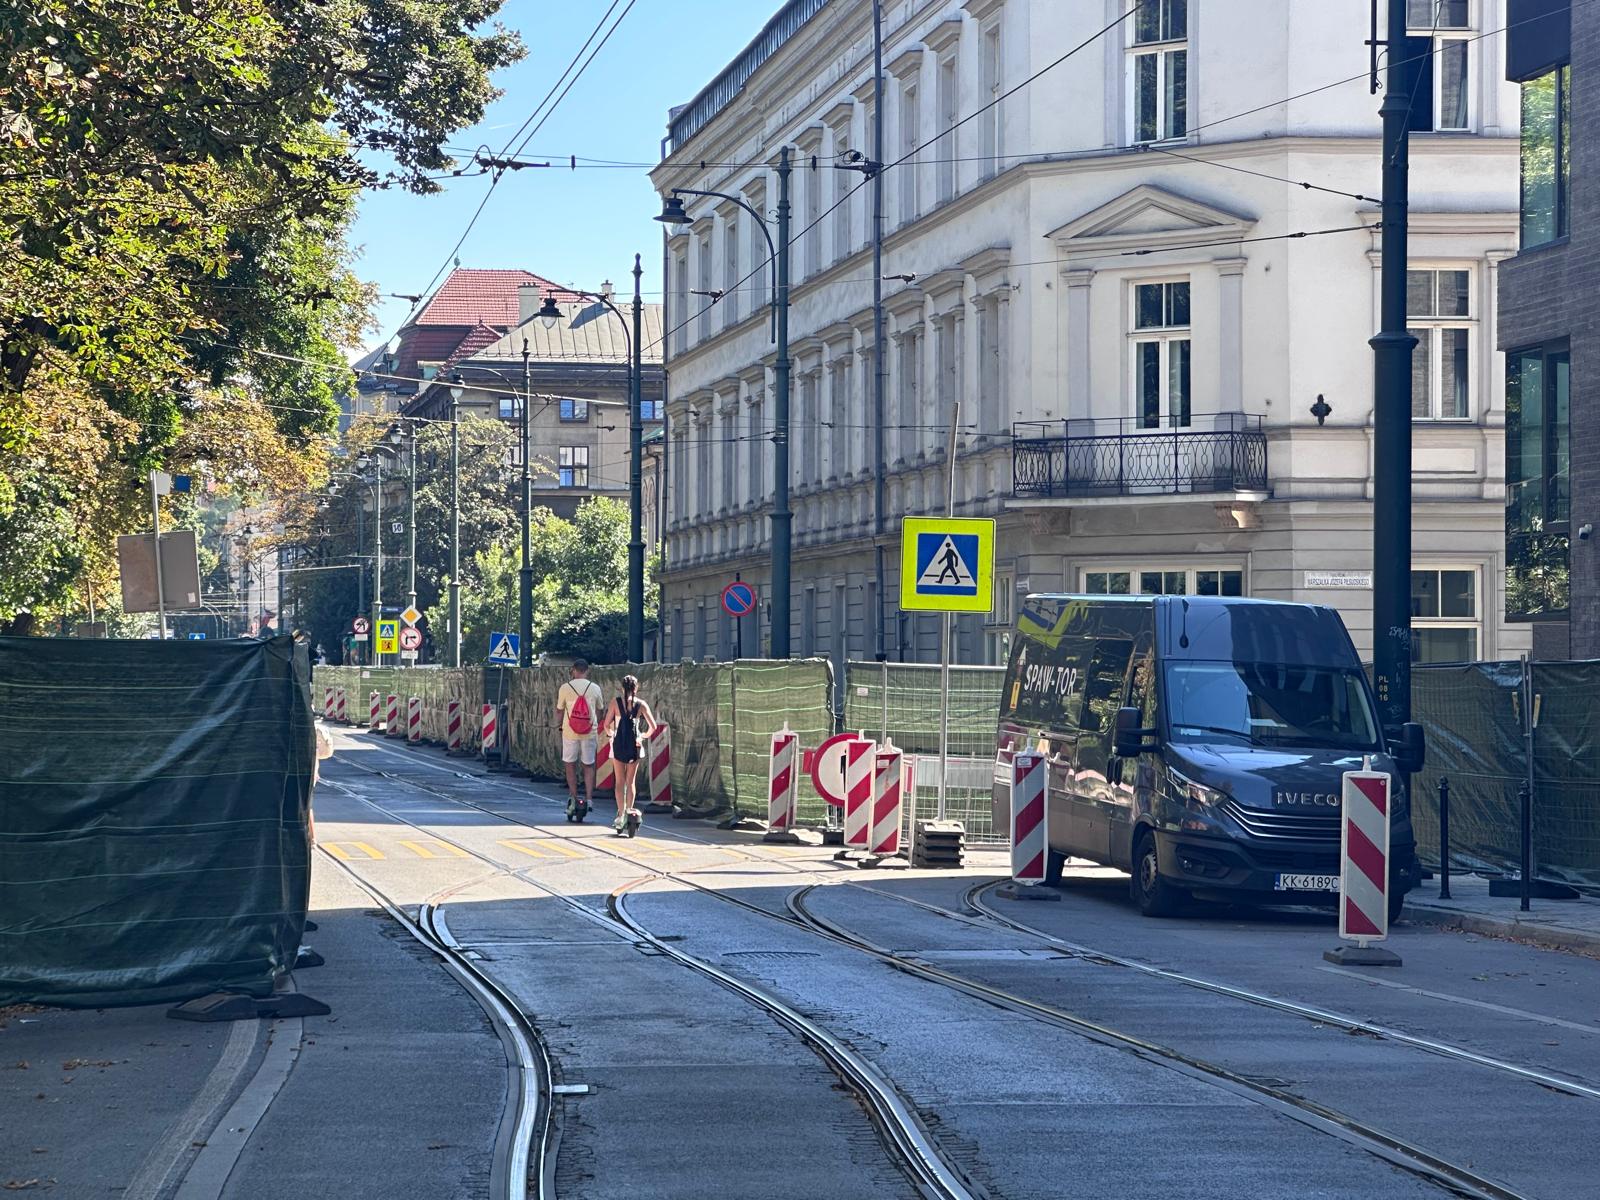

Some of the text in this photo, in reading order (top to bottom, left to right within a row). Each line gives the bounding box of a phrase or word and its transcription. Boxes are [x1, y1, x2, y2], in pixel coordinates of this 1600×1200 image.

[1024, 664, 1077, 696] SPAW-TOR
[1378, 675, 1389, 683] PL
[1277, 791, 1339, 807] IVECO
[1282, 875, 1299, 887] KK
